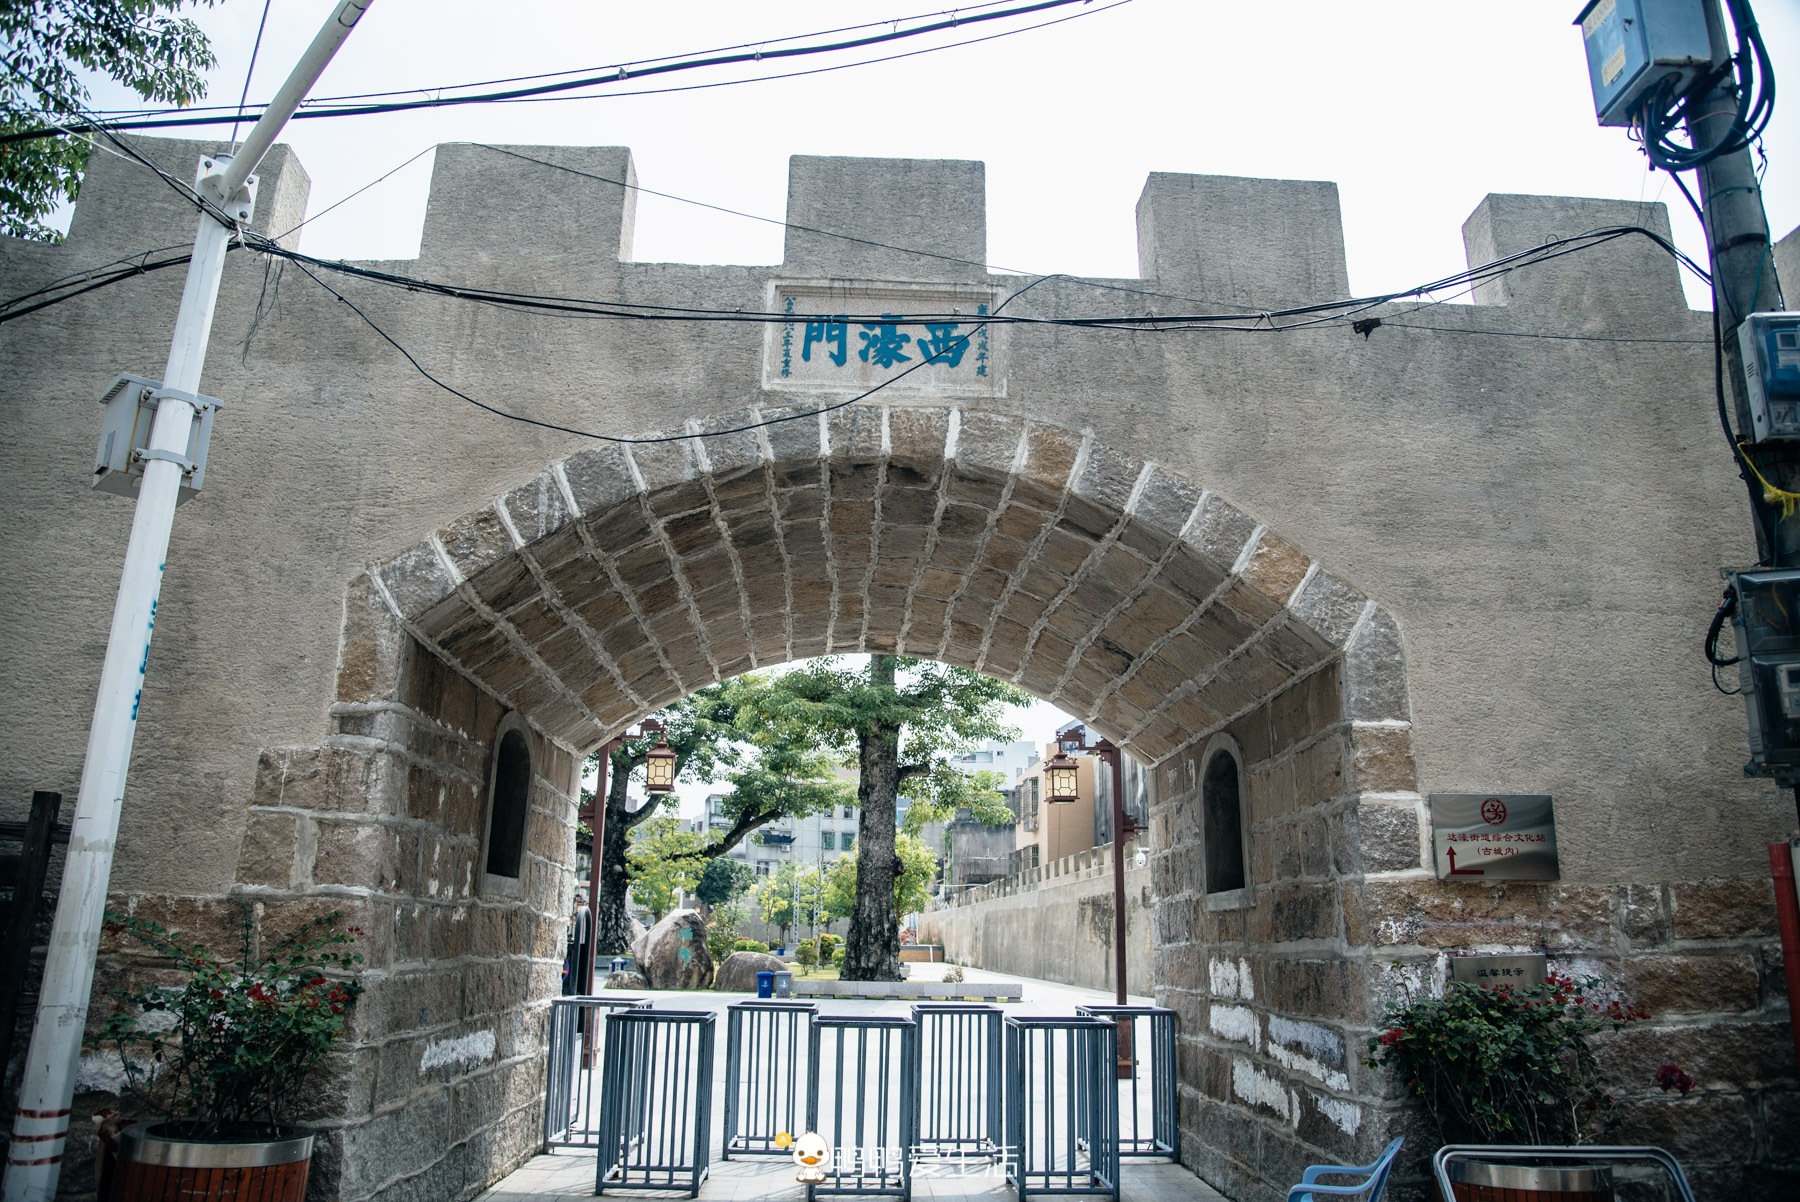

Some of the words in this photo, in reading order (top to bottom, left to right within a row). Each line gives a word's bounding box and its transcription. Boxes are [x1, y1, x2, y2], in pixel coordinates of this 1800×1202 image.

[1447, 833, 1546, 842] 达濠街道综合文化站
[1477, 967, 1524, 977] 温馨提示
